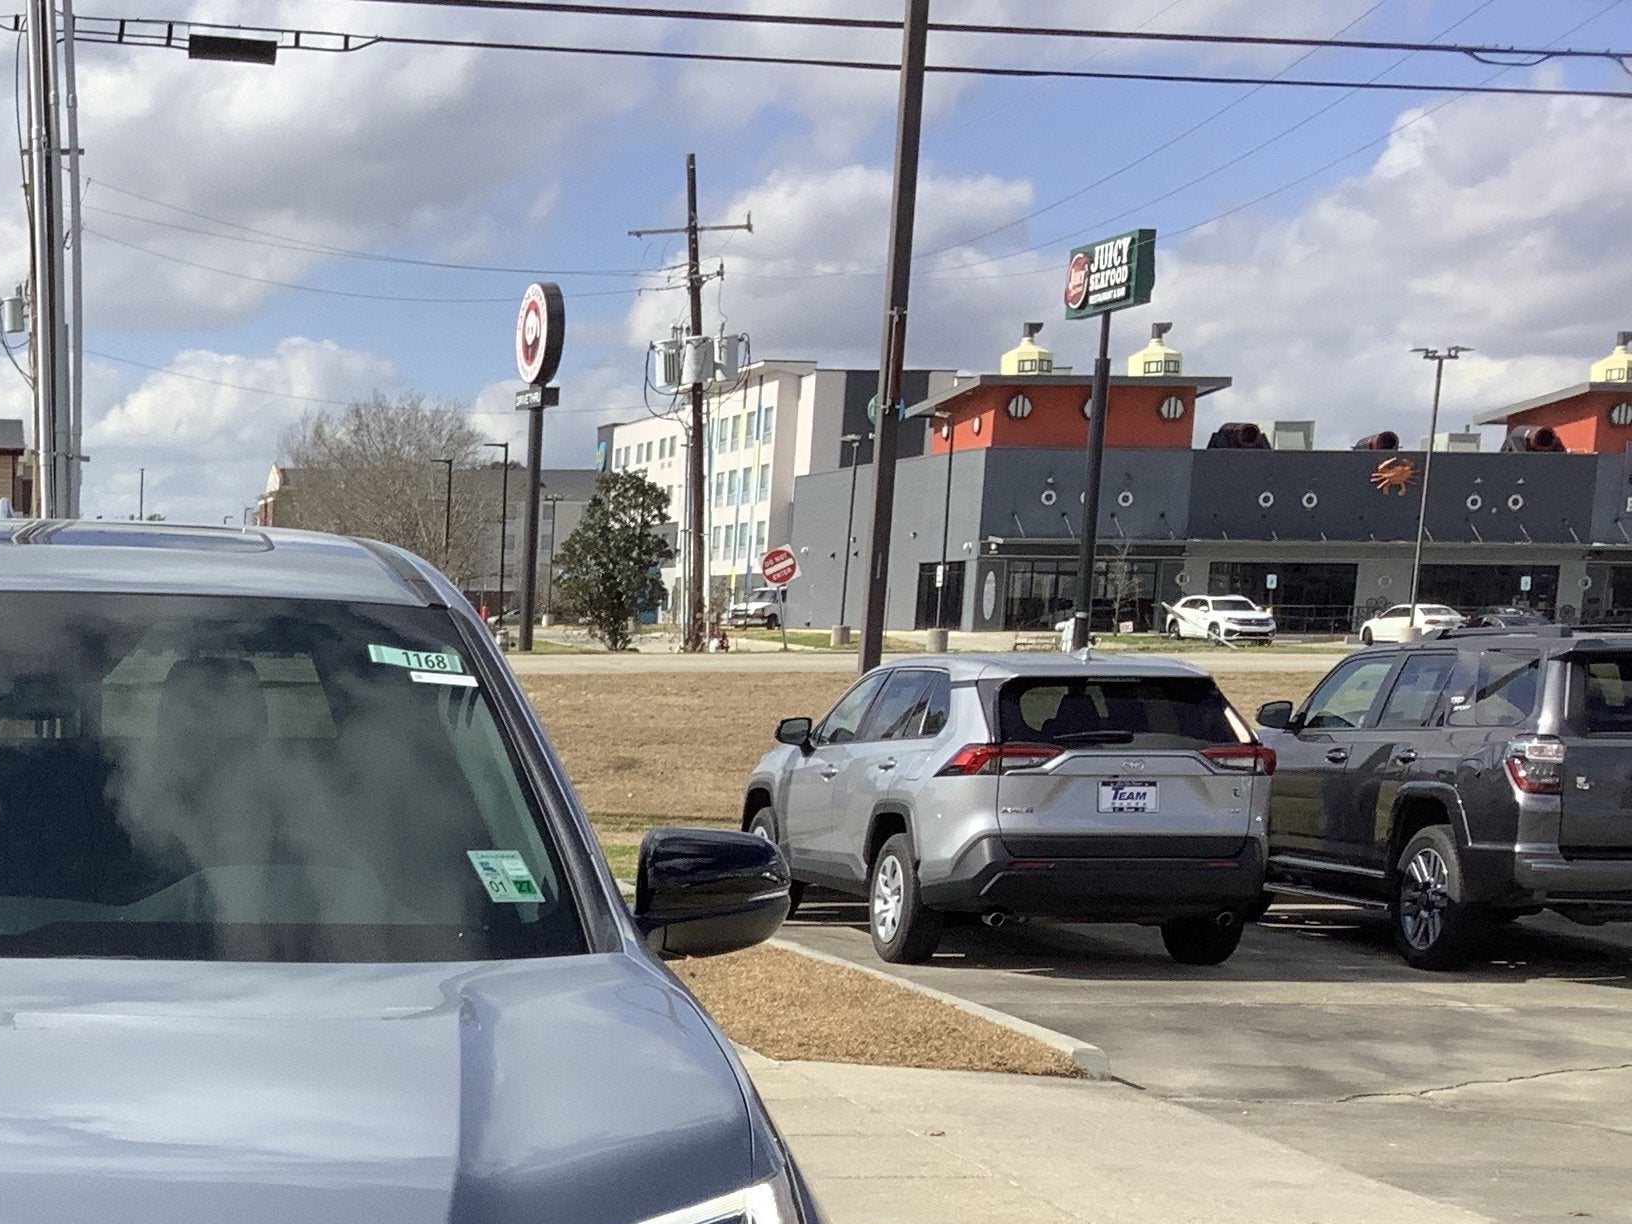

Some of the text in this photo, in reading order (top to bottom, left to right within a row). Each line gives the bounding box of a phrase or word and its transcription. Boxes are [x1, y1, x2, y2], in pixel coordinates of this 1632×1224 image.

[1090, 236, 1132, 273] JUICY
[1089, 265, 1129, 291] SEAFOOD
[402, 651, 447, 670] 1168
[1111, 785, 1147, 801] TEAM
[489, 880, 508, 893] 01
